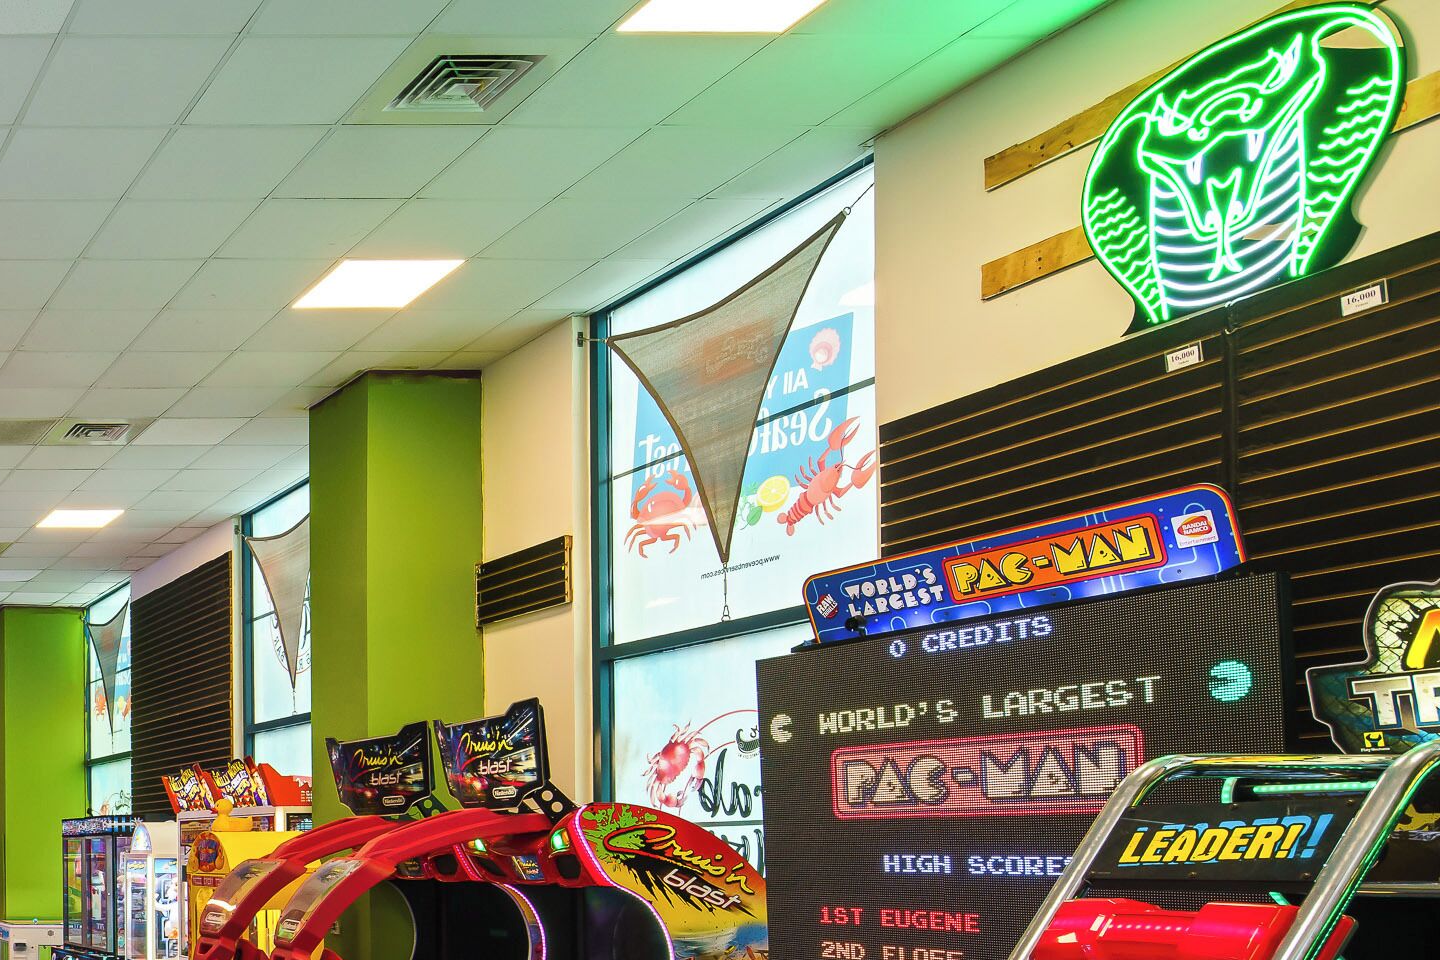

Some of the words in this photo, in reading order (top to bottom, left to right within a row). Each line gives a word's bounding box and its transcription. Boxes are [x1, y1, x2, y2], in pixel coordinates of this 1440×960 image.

[955, 523, 1154, 594] PAC-MAN
[845, 567, 937, 600] WORLD'S
[848, 584, 944, 617] LARGEST
[921, 615, 1053, 654] CREDITS
[818, 700, 959, 735] WORLD'S
[983, 675, 1162, 720] LARGEST
[370, 771, 403, 786] blast
[479, 757, 513, 775] blast
[843, 742, 1127, 807] PAC-MAN
[603, 824, 756, 896] Cruis'n
[883, 855, 951, 875] HIGH
[663, 868, 743, 910] blast
[820, 906, 864, 926] 1ST
[880, 909, 981, 933] EUGENE
[821, 941, 866, 960] 2ND
